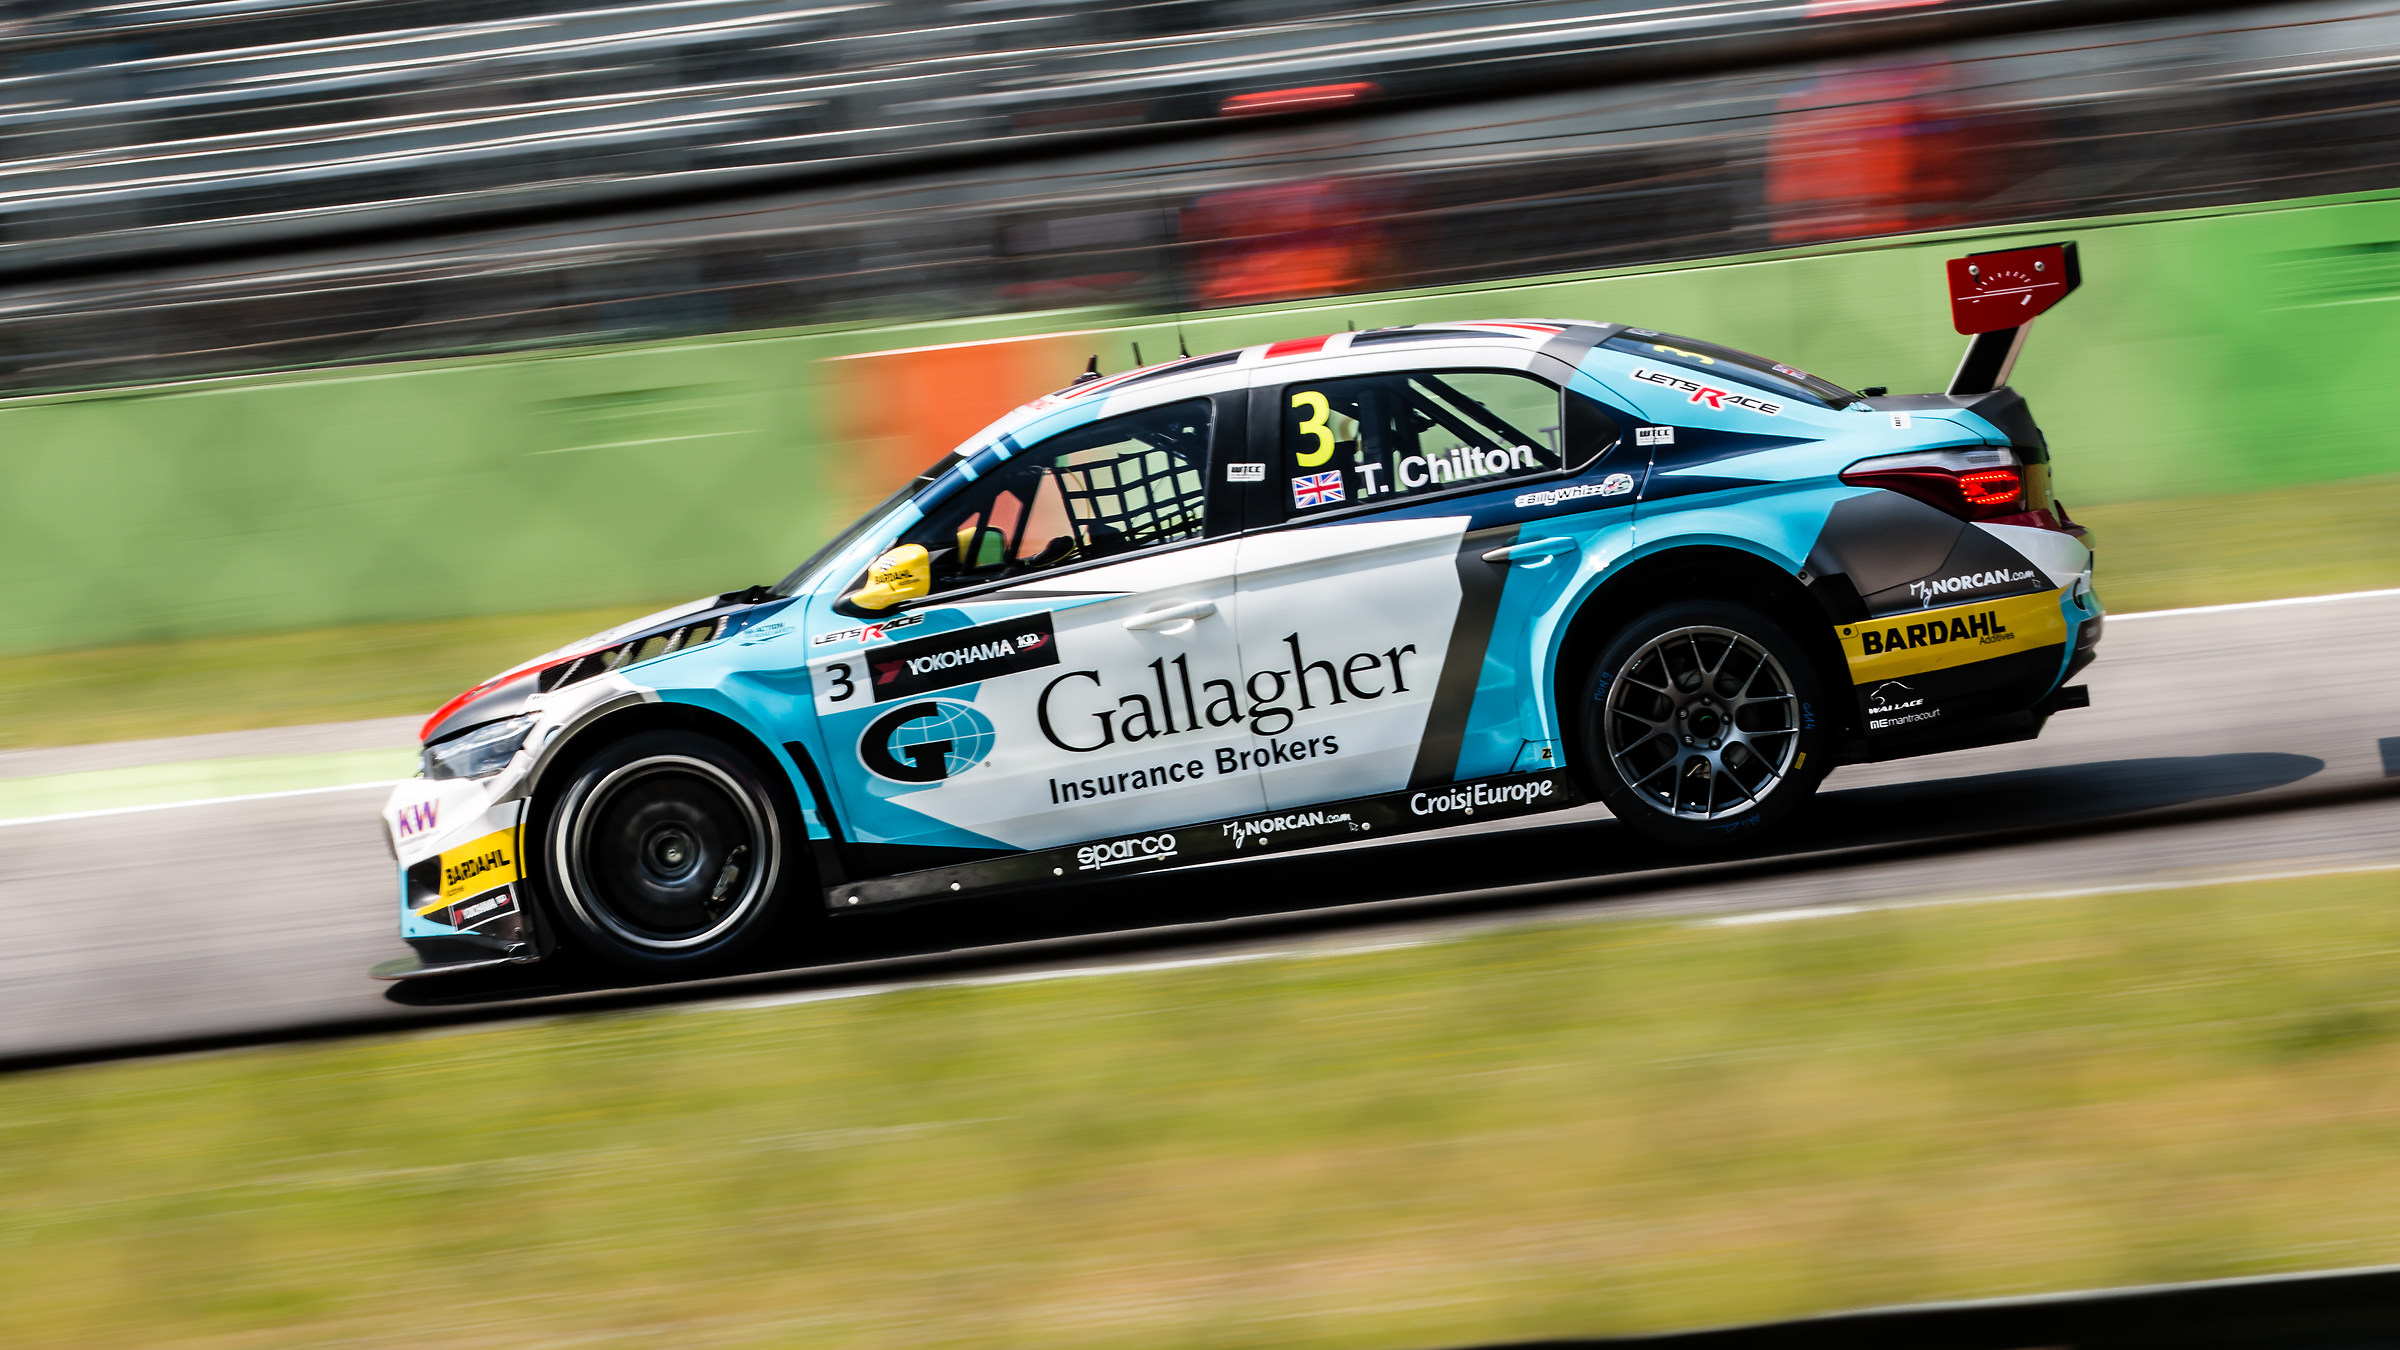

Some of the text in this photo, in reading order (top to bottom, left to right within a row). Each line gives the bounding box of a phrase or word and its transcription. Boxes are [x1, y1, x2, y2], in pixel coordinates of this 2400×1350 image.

[1291, 390, 1336, 468] 3
[1354, 462, 1390, 495] T.
[1399, 444, 1535, 488] Chilton
[1861, 610, 2006, 656] BARDAHL
[1979, 631, 2015, 646] Additives
[906, 638, 1016, 676] YOKOHAMA
[826, 663, 856, 703] 3
[1036, 631, 1417, 753] Gallagher
[1868, 698, 1924, 715] WALLACE
[1049, 734, 1340, 805] Insurance Brokers
[399, 799, 440, 838] KW
[1077, 833, 1177, 870] sparco
